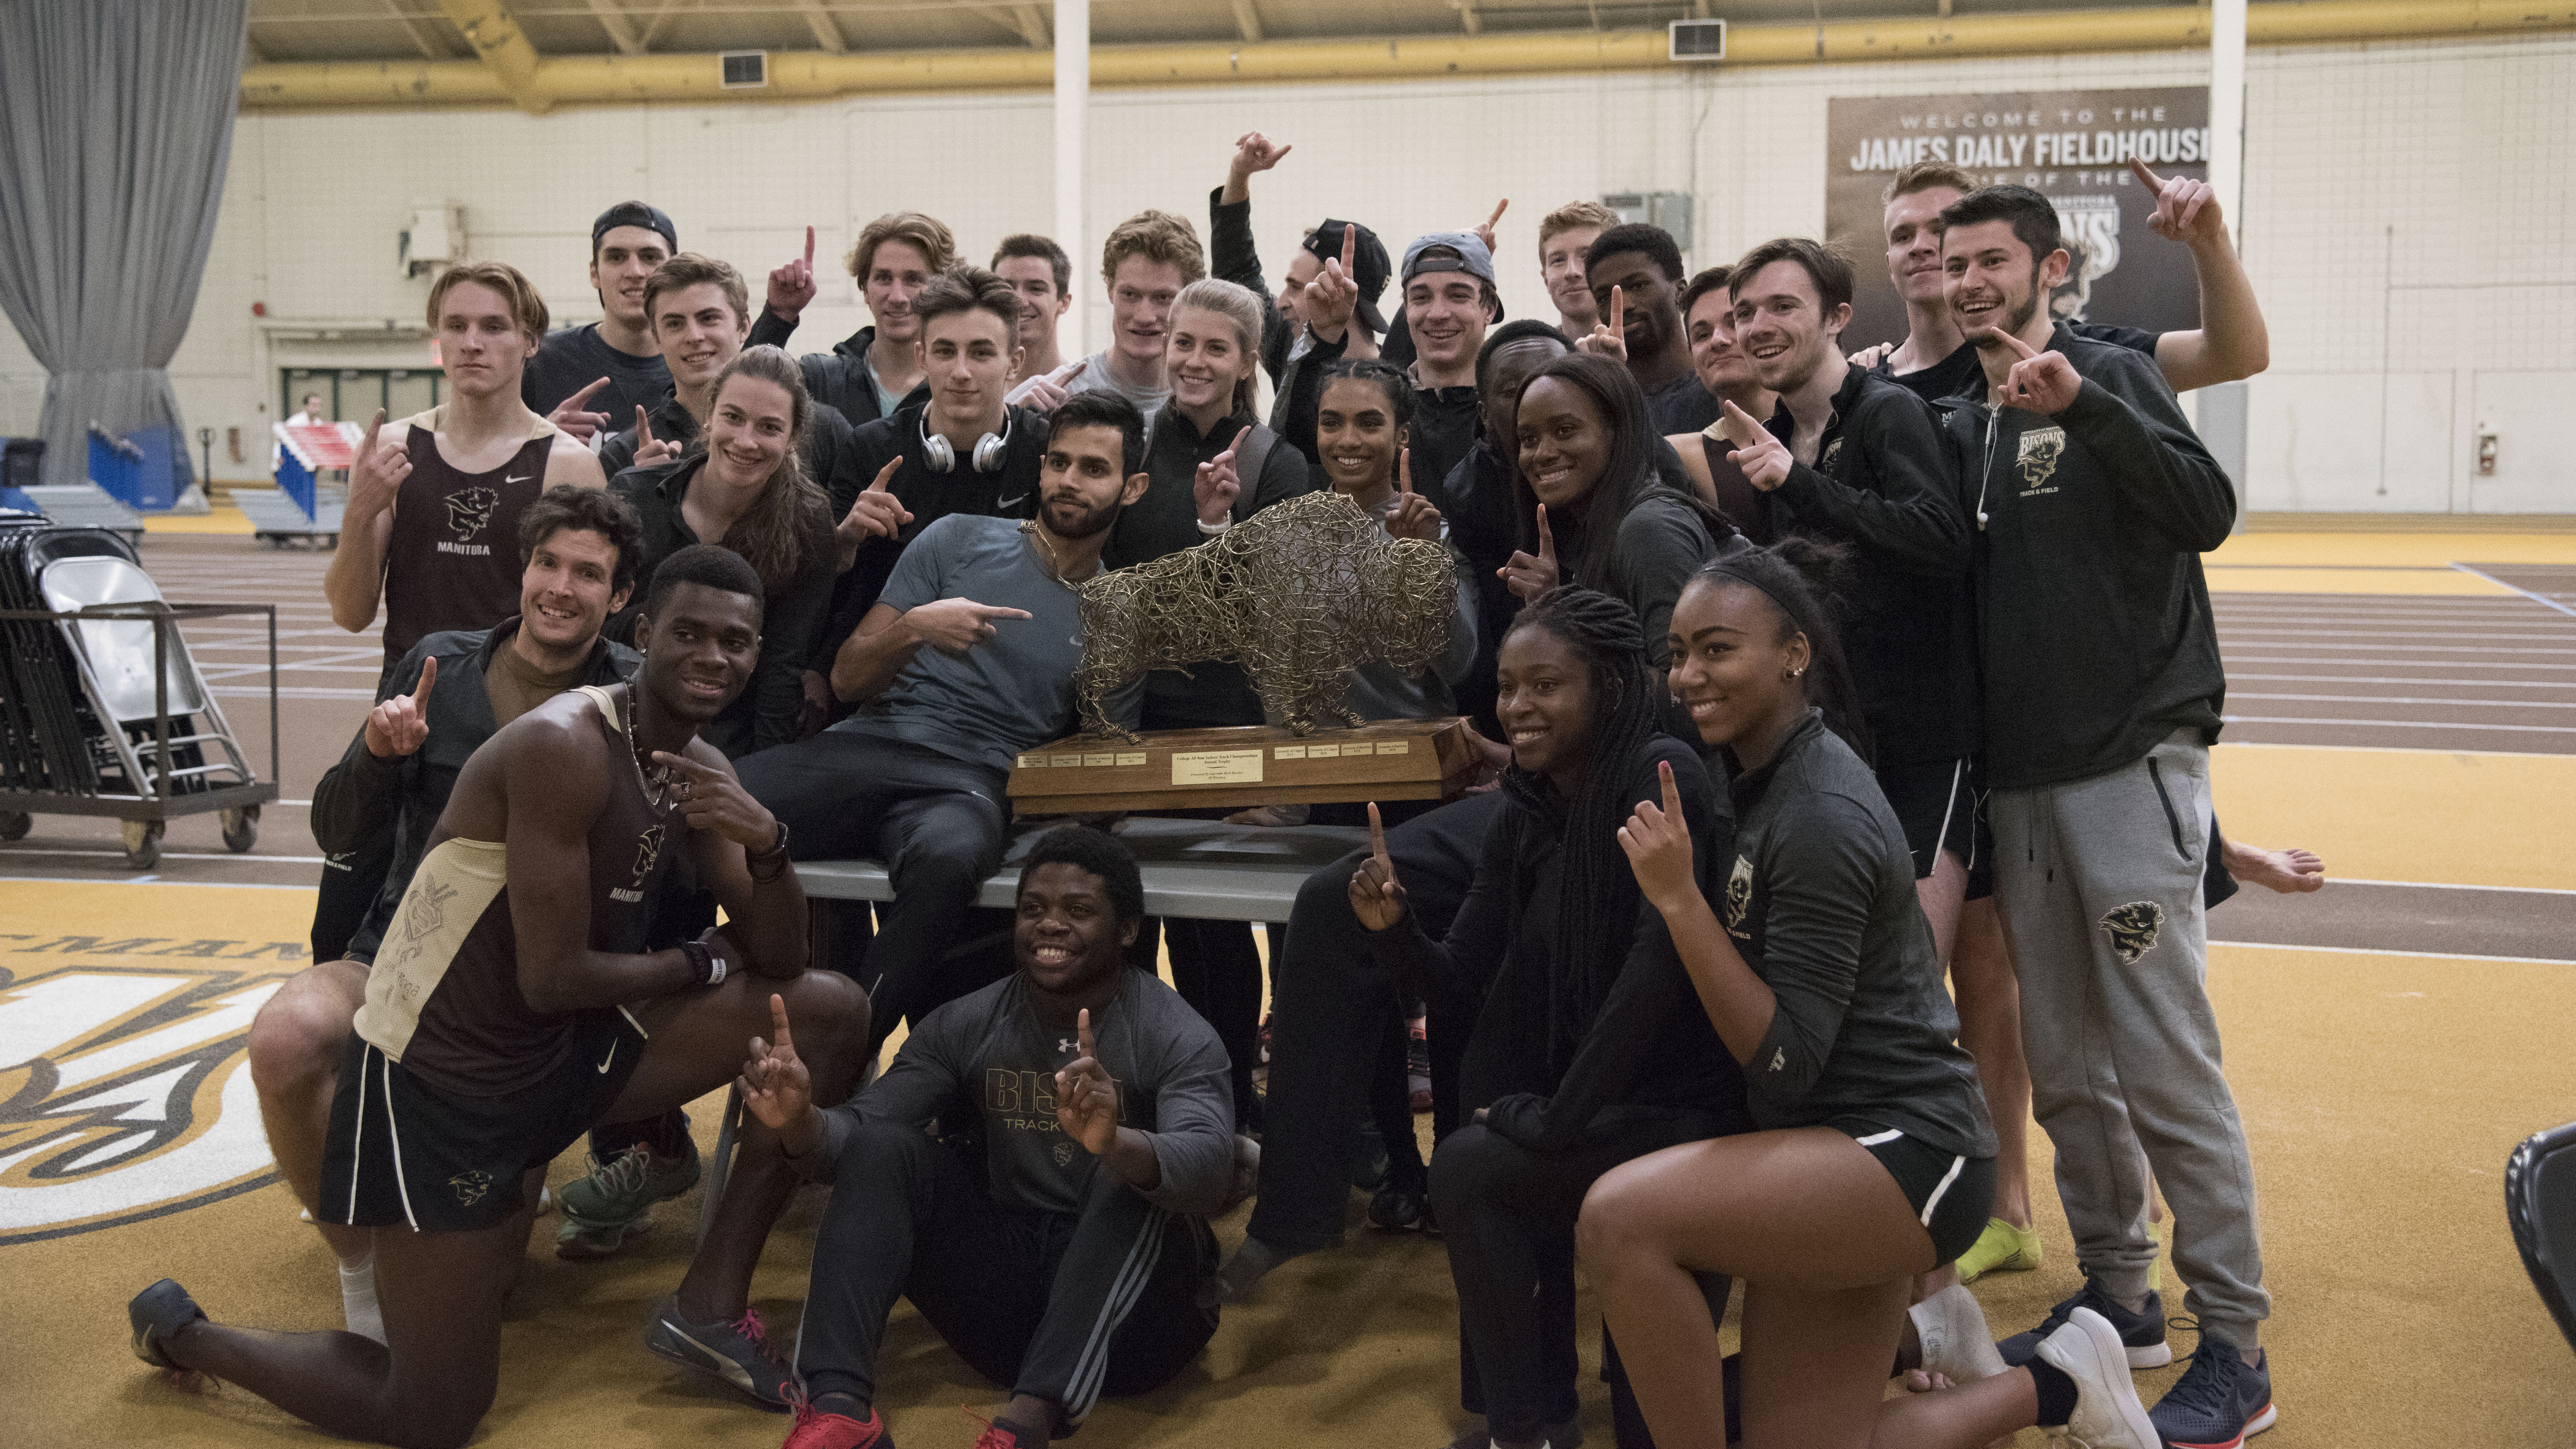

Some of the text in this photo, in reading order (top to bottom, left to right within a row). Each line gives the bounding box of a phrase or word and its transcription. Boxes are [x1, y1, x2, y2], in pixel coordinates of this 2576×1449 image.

[1900, 105, 2167, 130] WELCOME TO THE
[1850, 137, 1949, 170] JAMES
[1955, 133, 2027, 168] DALY
[2024, 170, 2130, 187] OF THE
[2020, 430, 2065, 456] BISONS
[437, 542, 490, 555] MANITOBA
[1004, 1118, 1061, 1132] TRACK
